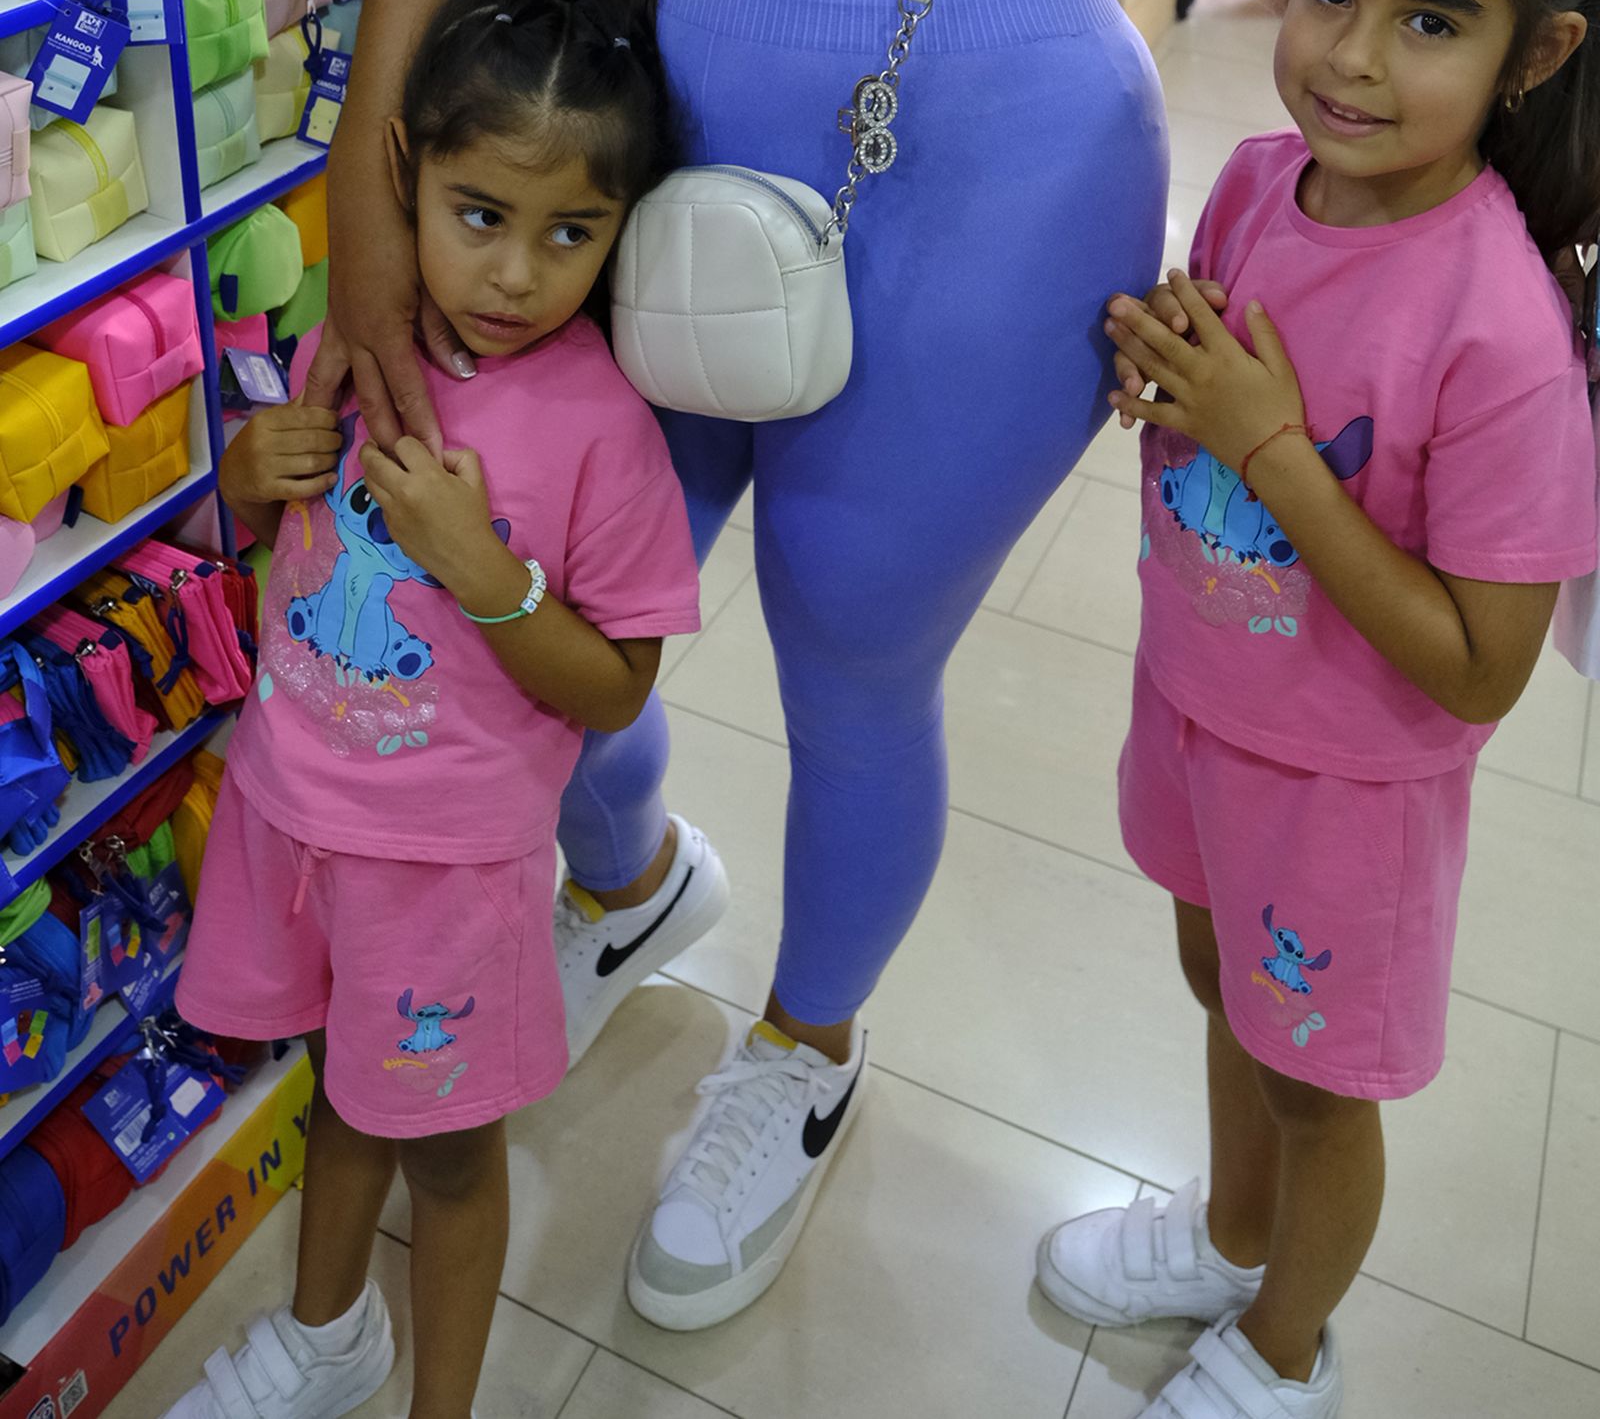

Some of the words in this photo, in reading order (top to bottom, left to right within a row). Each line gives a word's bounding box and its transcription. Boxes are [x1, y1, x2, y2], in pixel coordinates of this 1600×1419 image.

[54, 32, 92, 54] KANGOO
[107, 1193, 237, 1359] POWER
[247, 1138, 282, 1198] IN
